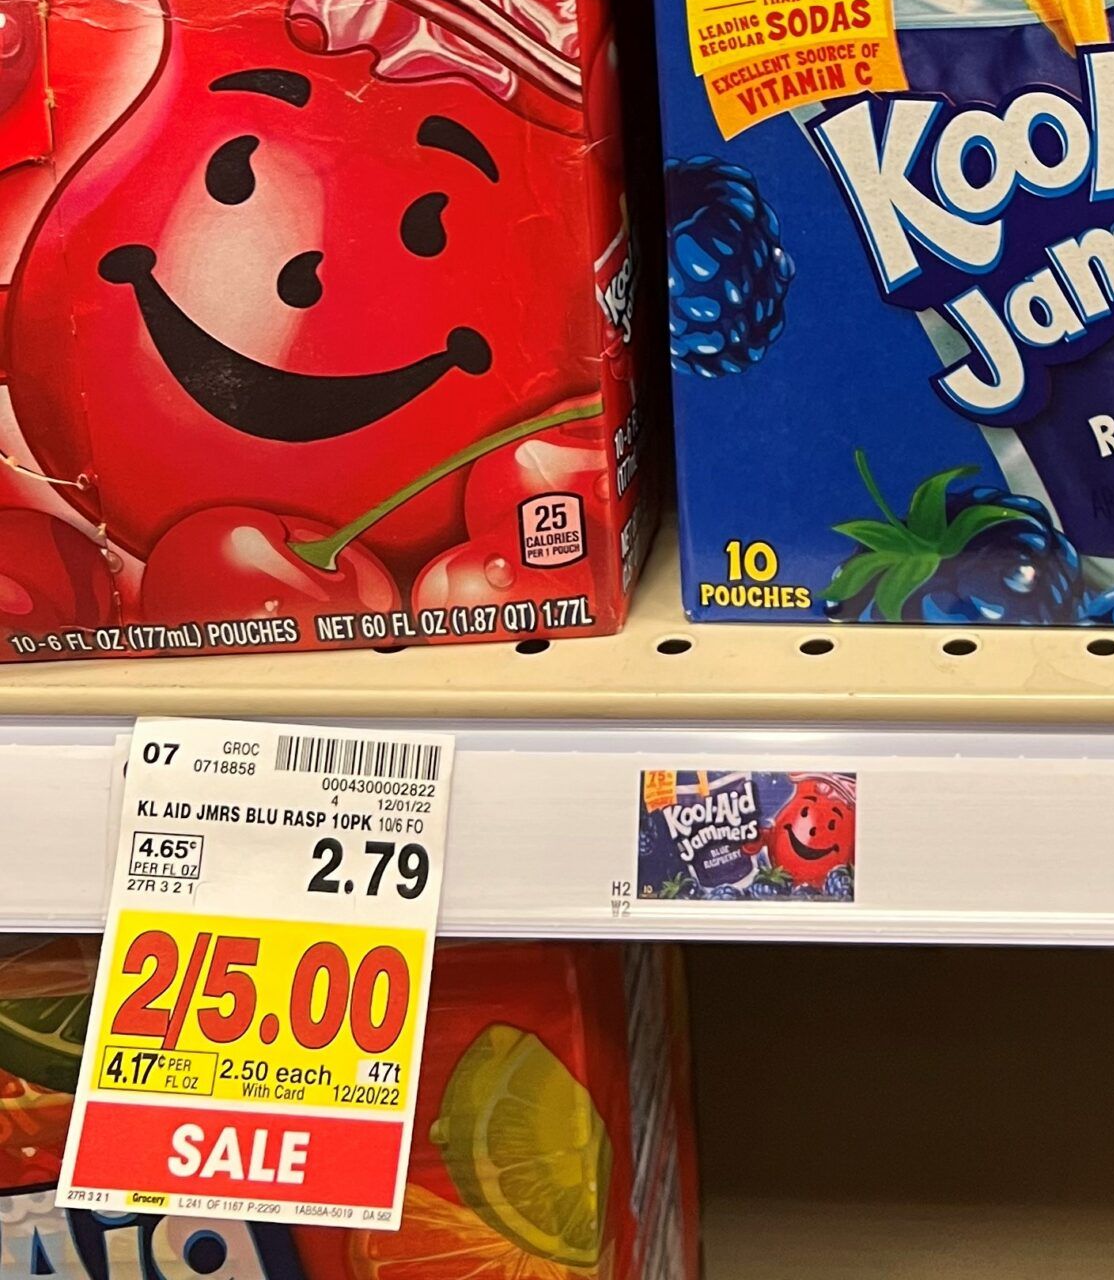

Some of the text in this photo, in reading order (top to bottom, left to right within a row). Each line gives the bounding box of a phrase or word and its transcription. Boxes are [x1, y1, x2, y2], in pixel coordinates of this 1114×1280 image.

[698, 15, 759, 41] LEADING
[699, 32, 764, 57] REGULAR
[711, 43, 880, 95] EXCELLENT SOURCE OF
[855, 62, 872, 86] C
[535, 503, 567, 532] 25
[526, 531, 579, 548] CALORIES
[528, 544, 580, 558] PER 1 POUCH
[726, 541, 777, 581] 10
[700, 584, 811, 608] POUCHES
[318, 598, 592, 639] NET 60 FL OZ (1.87 QT) 1.77L
[66, 634, 92, 651] FL
[98, 630, 124, 650] OZ
[128, 625, 202, 648] (177mL)
[208, 619, 297, 645] POUCHES
[143, 742, 179, 765] 07
[223, 741, 260, 756] GROC
[194, 759, 256, 776] 0718858
[322, 778, 436, 798] 0004300002822
[331, 795, 432, 813] 4 12/01/22
[663, 782, 756, 839] Kool-Aid
[137, 800, 424, 834] KL AID JMRS BLU RASP 10PK 10/6 FO
[680, 820, 757, 861] Jammers
[134, 862, 197, 876] PER FL OZ
[307, 837, 430, 899] 2.79
[127, 879, 193, 894] 27R 3 2 1
[612, 881, 631, 896] H2
[110, 930, 410, 1054] 2/5.00
[168, 1058, 191, 1071] PER
[220, 1059, 331, 1085] 2.50 each
[368, 1062, 401, 1083] 47t
[165, 1076, 198, 1089] FL OZ
[242, 1084, 305, 1100] With Card
[333, 1085, 399, 1106] 12/20/22
[168, 1123, 310, 1184] SALE
[132, 1193, 165, 1206] Grocery
[207, 1200, 220, 1209] OF
